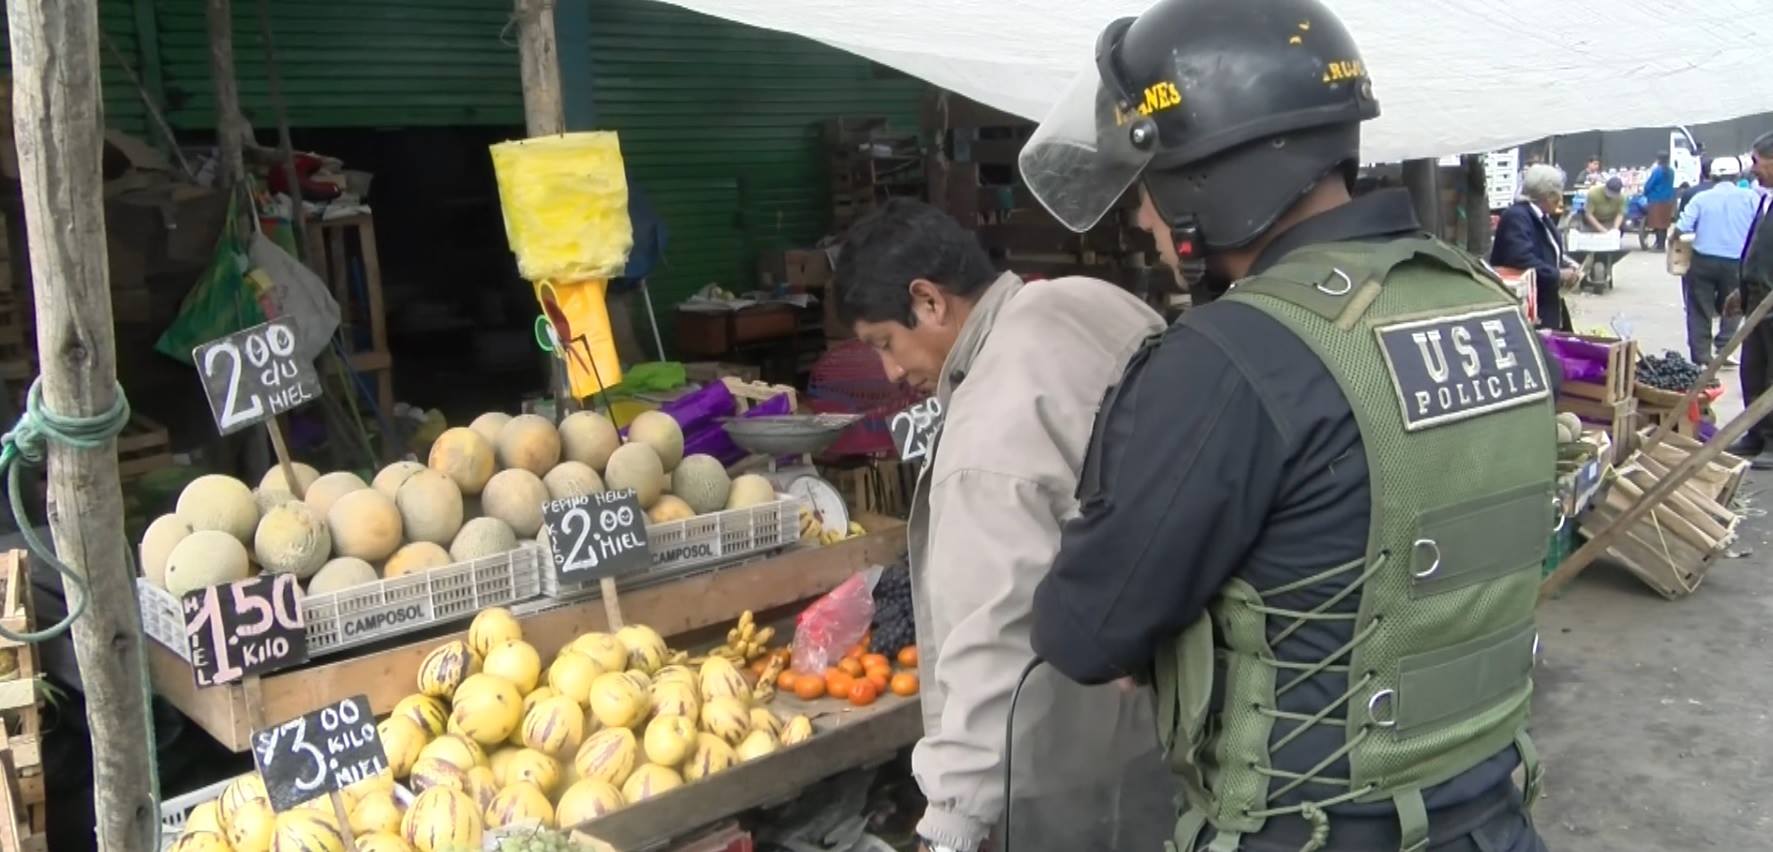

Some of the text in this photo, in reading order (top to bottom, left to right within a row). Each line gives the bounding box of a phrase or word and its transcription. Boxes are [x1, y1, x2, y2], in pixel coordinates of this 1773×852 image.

[1411, 319, 1519, 384] USE
[1414, 368, 1539, 416] POLICIA
[651, 543, 713, 565] CAMPOSOL
[344, 604, 425, 636] CAMPOSOL
[328, 723, 375, 754] KILO
